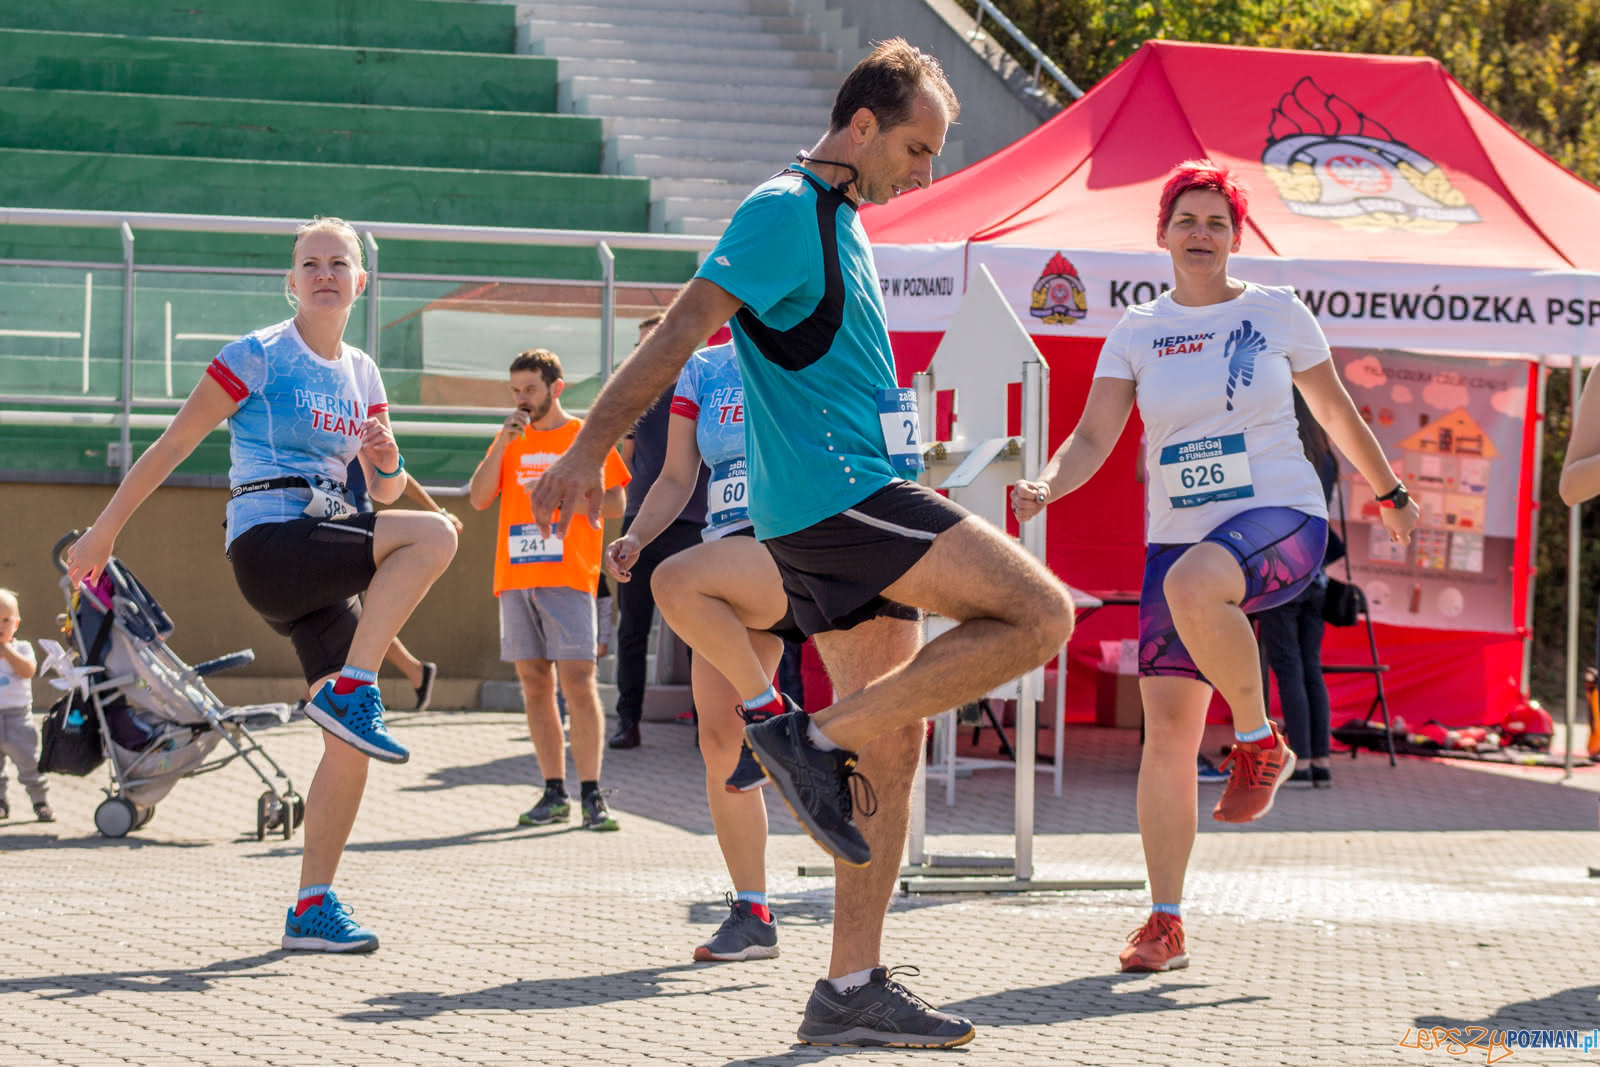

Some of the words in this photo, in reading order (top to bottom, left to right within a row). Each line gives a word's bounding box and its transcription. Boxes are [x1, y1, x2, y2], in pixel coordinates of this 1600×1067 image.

[892, 278, 901, 296] W
[903, 276, 954, 297] POZNANIU
[1294, 285, 1536, 324] WOJEWÓDZKA
[1547, 297, 1600, 327] PSP
[1158, 342, 1203, 358] TEAM
[311, 409, 364, 439] TEAM
[1178, 438, 1223, 455] zaBIEGaj
[1181, 463, 1225, 489] 626
[723, 482, 745, 503] 60
[520, 539, 545, 553] 241
